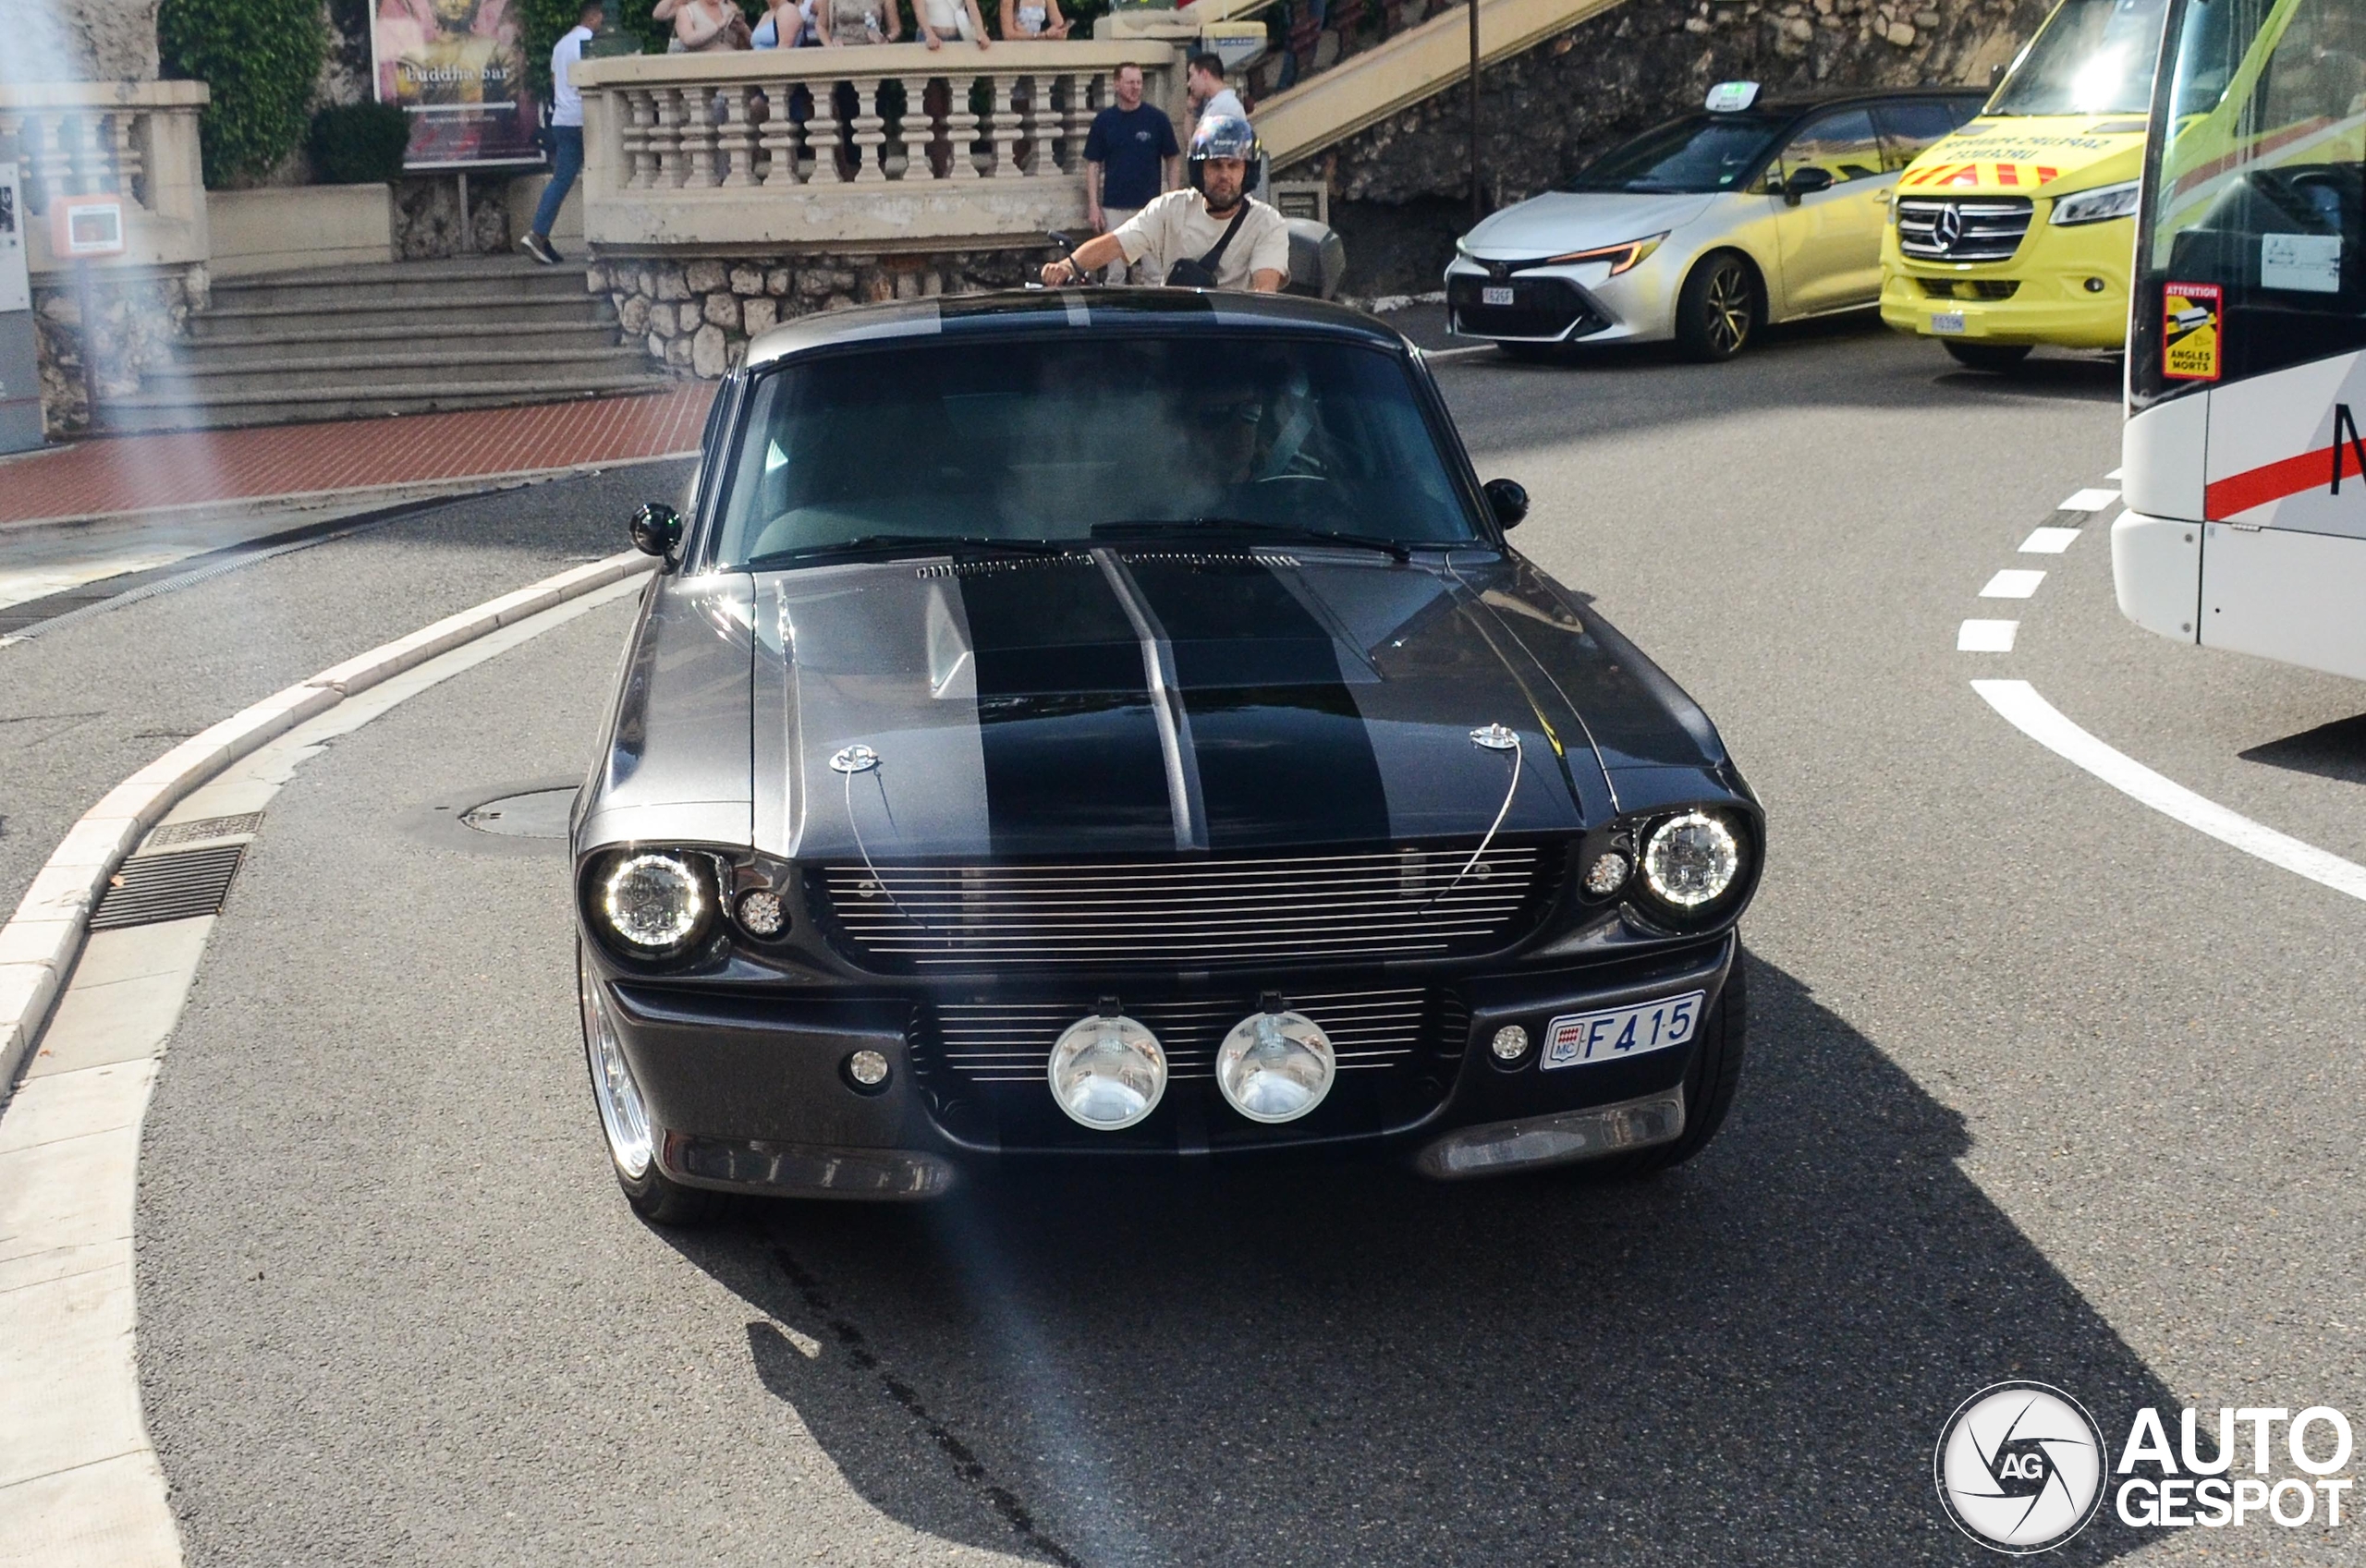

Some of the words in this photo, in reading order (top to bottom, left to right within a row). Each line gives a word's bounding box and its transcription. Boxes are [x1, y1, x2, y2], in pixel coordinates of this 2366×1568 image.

[405, 65, 474, 82] buddha
[482, 66, 509, 81] bar
[2165, 286, 2218, 298] ATTENTION
[2170, 350, 2211, 361] ANGLES
[2172, 360, 2209, 371] MORTS
[1555, 1043, 1575, 1055] MC
[1584, 1001, 1693, 1059] F415
